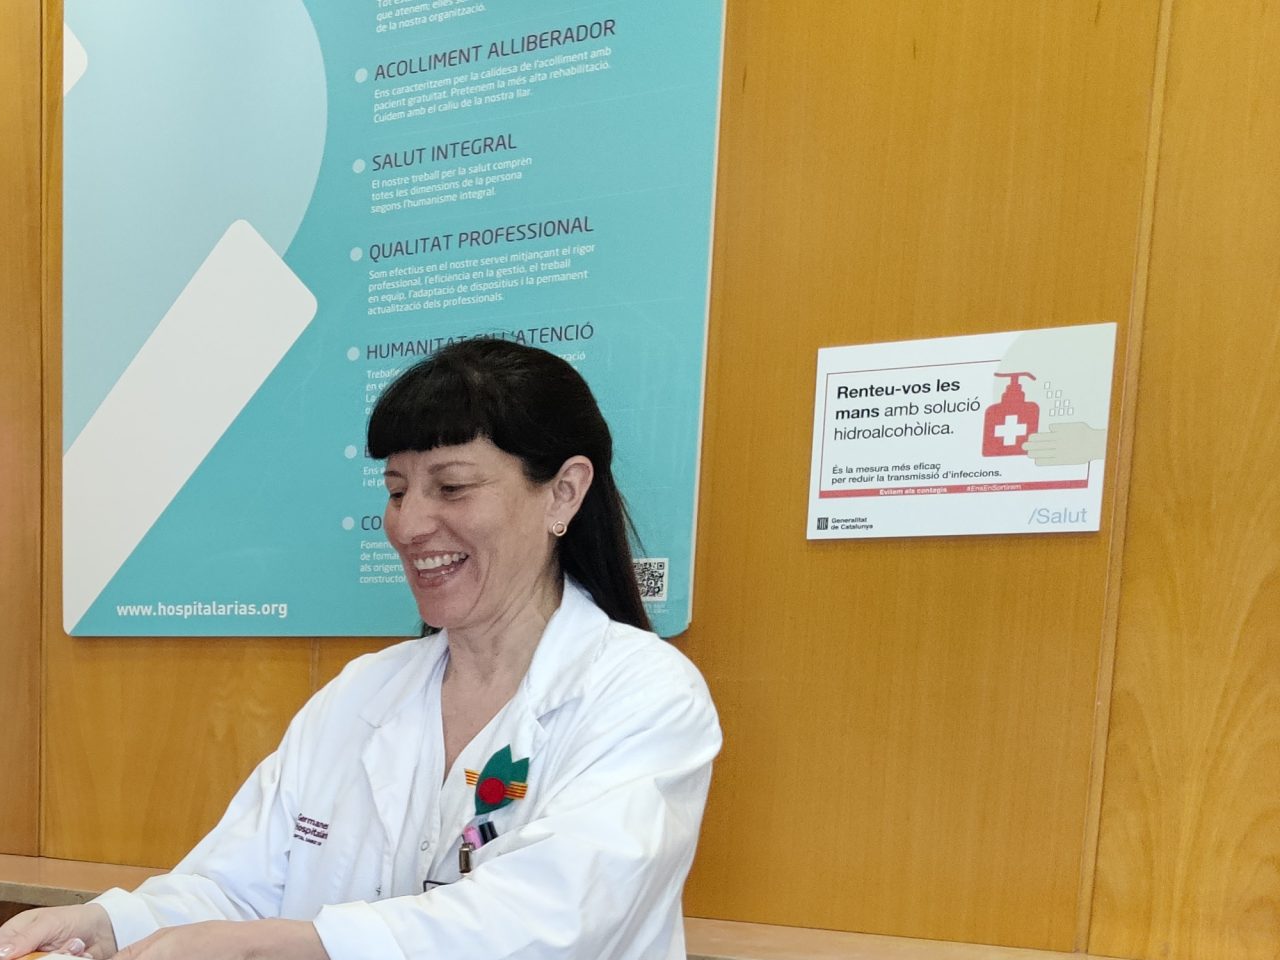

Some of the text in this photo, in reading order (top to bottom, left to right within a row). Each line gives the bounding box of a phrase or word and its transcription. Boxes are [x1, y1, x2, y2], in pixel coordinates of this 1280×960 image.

[376, 24, 388, 33] de
[389, 22, 397, 30] la
[398, 16, 427, 28] nostra
[375, 19, 616, 81] ACOLLIMENT ALLIBERADOR
[374, 88, 390, 99] Ens
[453, 74, 468, 86] per
[470, 70, 480, 81] la
[520, 60, 532, 72] de
[590, 47, 612, 59] amb
[450, 83, 495, 97] Pretenem
[497, 78, 506, 89] la
[507, 74, 527, 87] més
[529, 71, 548, 83] alta
[373, 110, 405, 124] Cuidem
[407, 107, 426, 118] amb
[427, 104, 436, 114] el
[460, 97, 472, 109] de
[474, 95, 483, 106] la
[484, 91, 514, 104] nostra
[372, 133, 517, 171] SALUT INTEGRAL
[372, 179, 380, 189] El
[382, 176, 410, 188] nostre
[411, 170, 440, 183] treball
[441, 169, 456, 180] per
[458, 166, 467, 176] la
[468, 163, 491, 174] salut
[372, 172, 522, 200] totes les dimensions de la persona
[371, 202, 401, 214] segons
[403, 194, 458, 208] l'humanisme
[369, 215, 594, 263] QUALITAT PROFESSIONAL
[369, 269, 387, 280] Som
[389, 264, 424, 277] efectius
[426, 264, 438, 273] en
[439, 261, 448, 271] el
[449, 258, 479, 270] nostre
[480, 255, 508, 266] servei
[561, 245, 571, 255] el
[572, 243, 595, 256] rigor
[472, 272, 484, 280] en
[485, 268, 494, 278] la
[529, 262, 538, 272] el
[540, 258, 571, 270] treball
[368, 295, 379, 303] en
[457, 283, 468, 293] de
[470, 277, 519, 293] dispositius
[525, 275, 535, 285] la
[536, 271, 588, 286] permanent
[367, 301, 422, 315] actualització
[423, 298, 441, 309] dels
[836, 378, 960, 400] Renteu-vos les
[835, 396, 981, 420] mans amb solució
[833, 421, 954, 441] hidroalcohòlica.
[363, 466, 378, 476] Ens
[831, 469, 1002, 486] per reduir la transmissió d'infeccions.
[832, 461, 941, 475] És la mesura més eficaç
[840, 523, 873, 531] Catalunya
[360, 553, 371, 561] de
[360, 563, 372, 572] als
[116, 601, 288, 619] www.hospitalarias.org
